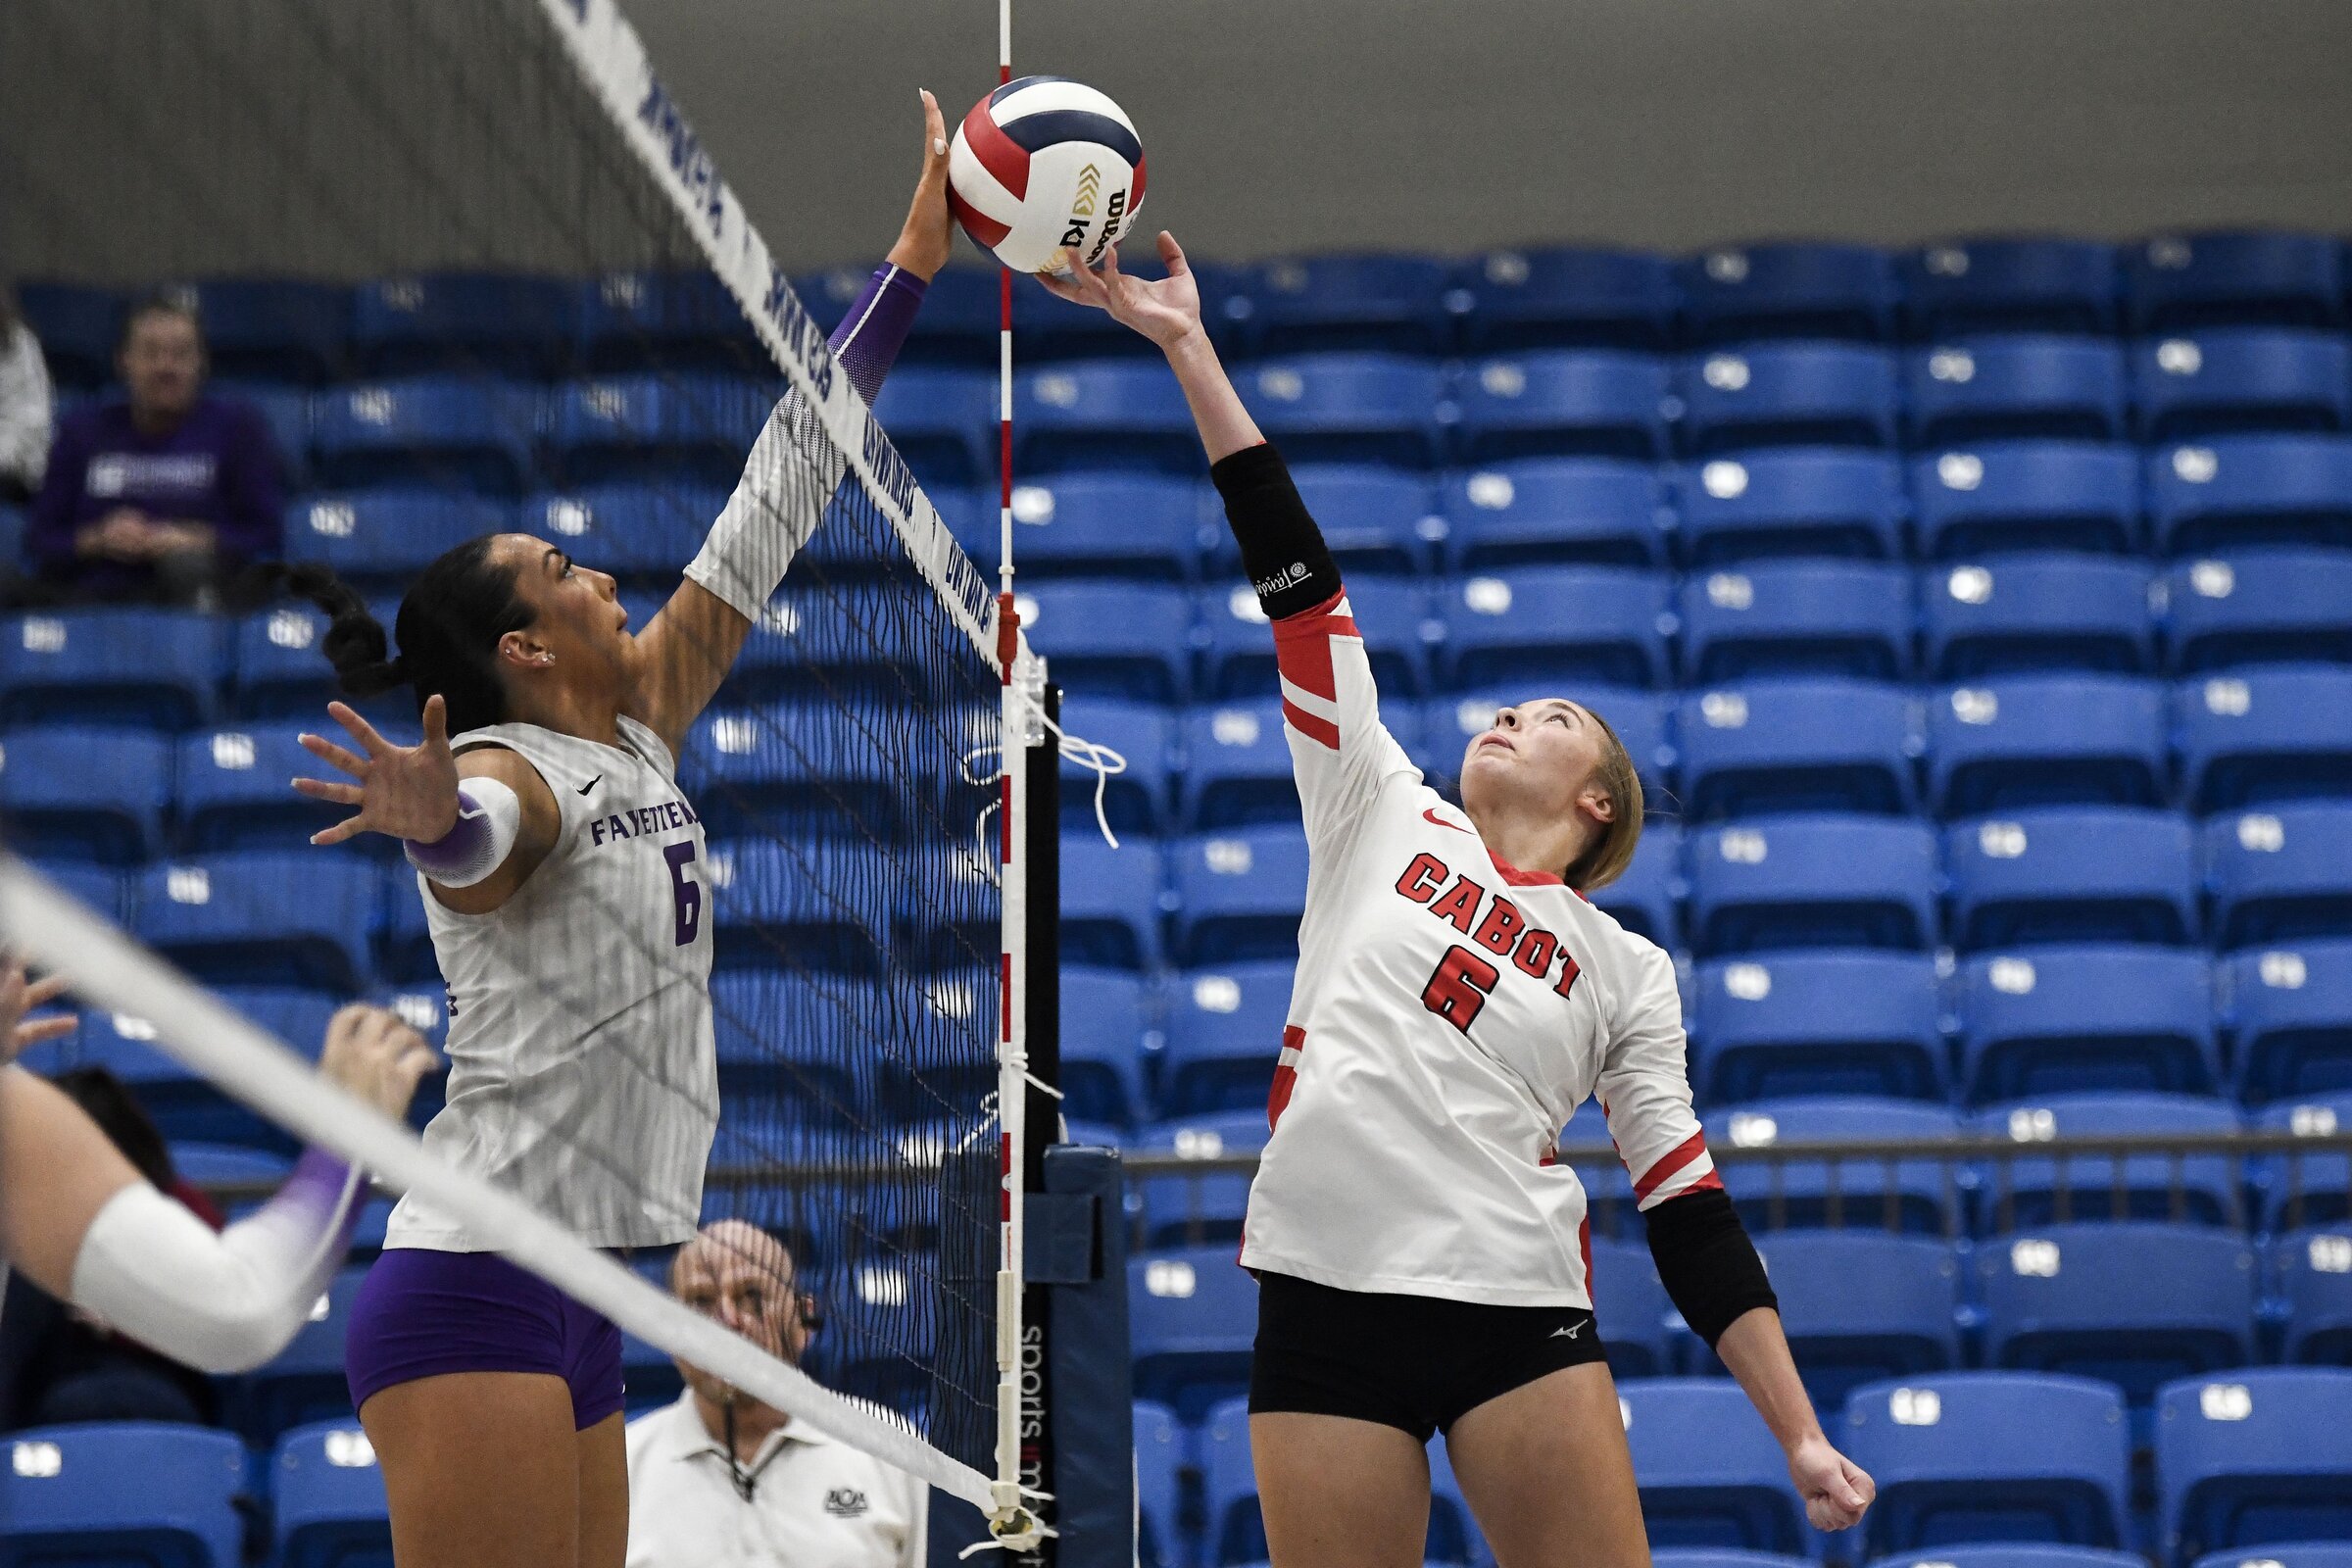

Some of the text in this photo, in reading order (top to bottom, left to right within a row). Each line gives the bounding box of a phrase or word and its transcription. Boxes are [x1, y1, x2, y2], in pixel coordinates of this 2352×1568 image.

[1086, 188, 1126, 264] Wilson
[662, 840, 701, 947] 6
[1395, 853, 1581, 1002] CABOT
[1420, 944, 1500, 1036] 6
[1021, 1325, 1046, 1439] sports
